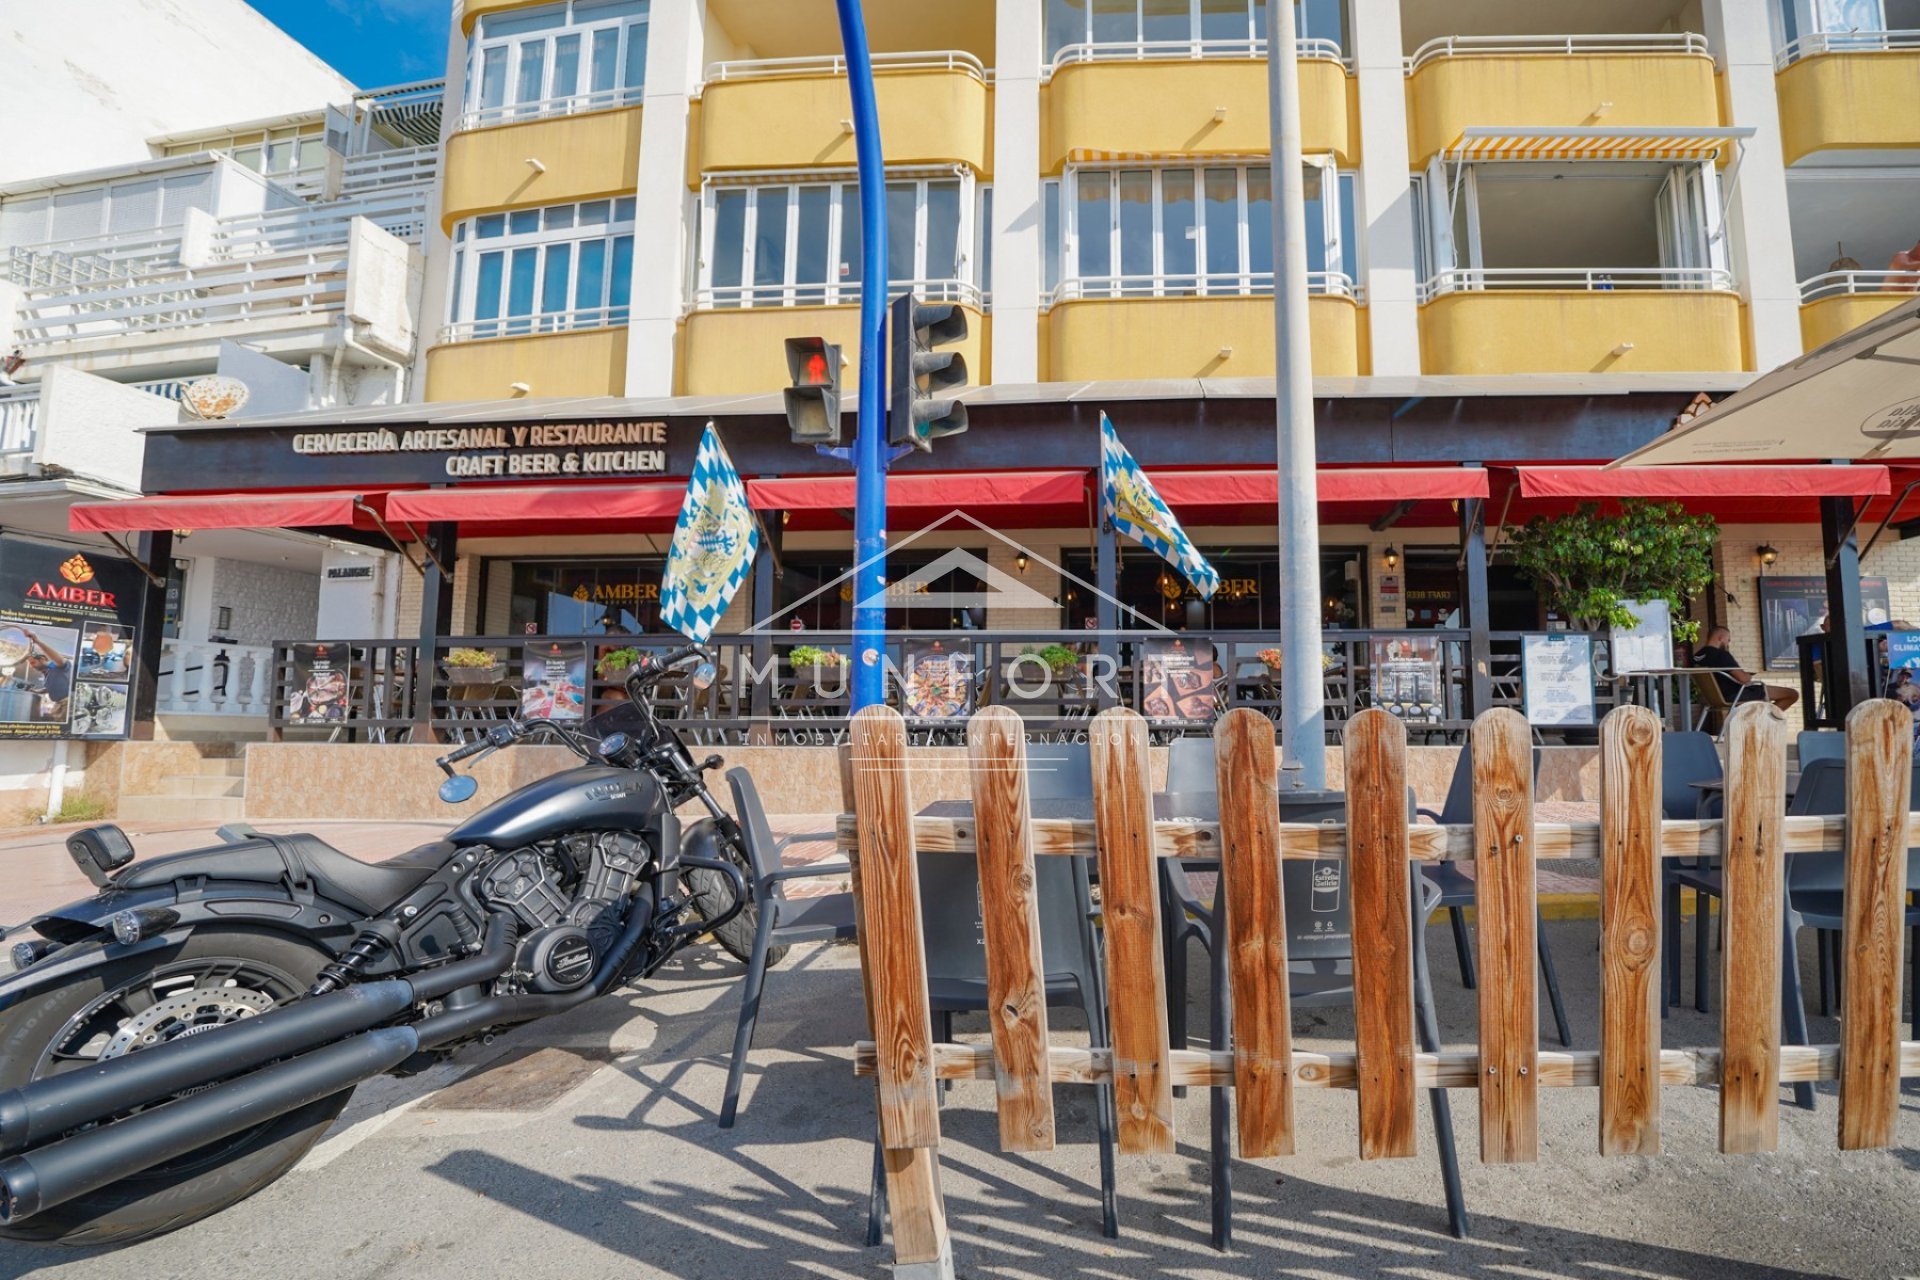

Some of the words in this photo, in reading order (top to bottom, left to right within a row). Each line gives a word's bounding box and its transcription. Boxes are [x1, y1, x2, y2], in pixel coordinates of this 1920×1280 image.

[293, 427, 399, 453] CERVECERÍA
[400, 427, 510, 450] ARTESANAL
[512, 426, 528, 447] Y
[530, 422, 667, 446] RESTAURANTE
[445, 455, 507, 476] CRAFT
[508, 453, 560, 475] BEER
[562, 452, 580, 473] &
[582, 450, 666, 473] KITCHEN
[26, 581, 118, 608] AMBER
[592, 584, 659, 599] AMBER
[1184, 579, 1259, 595] ABER
